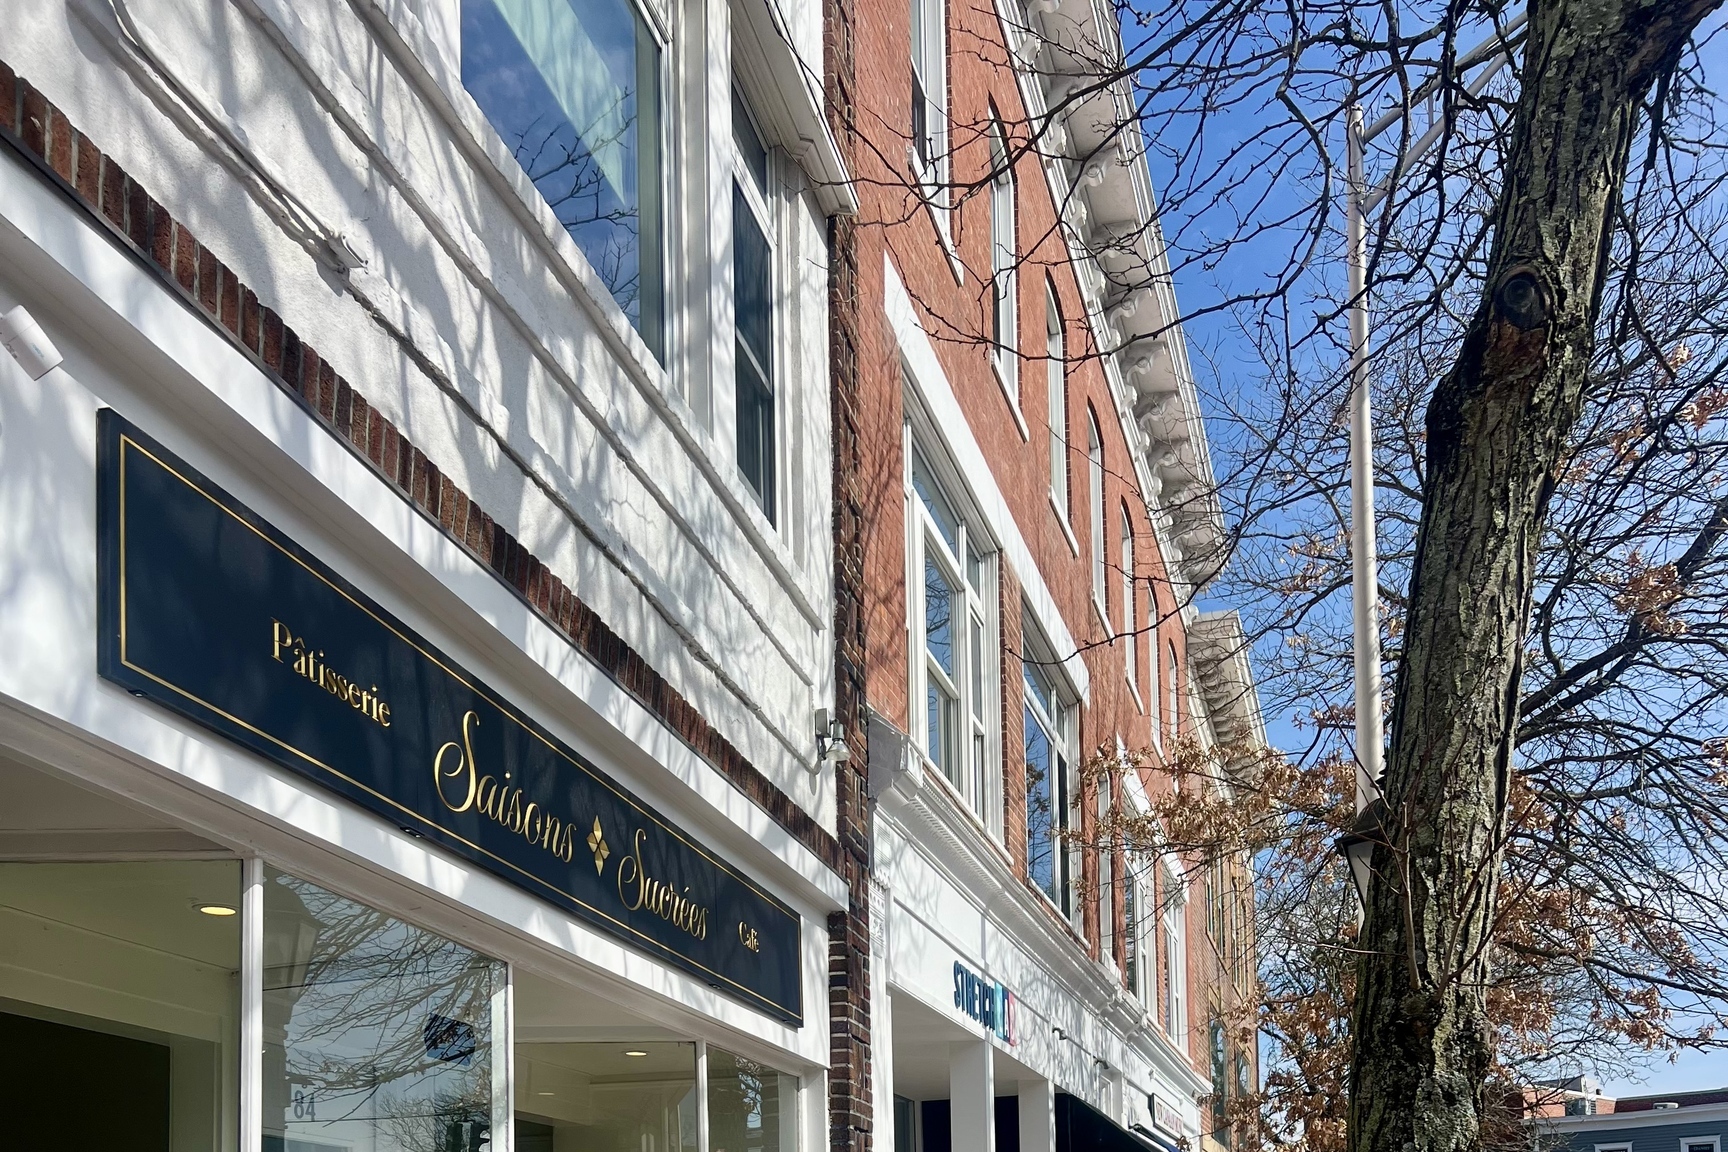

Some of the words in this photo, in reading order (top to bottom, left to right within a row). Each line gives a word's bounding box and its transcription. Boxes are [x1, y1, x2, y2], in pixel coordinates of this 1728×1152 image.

[271, 617, 391, 727] Pâtisserie
[434, 710, 577, 863] Saisons
[617, 828, 709, 941] Sucrées
[294, 1090, 316, 1122] 84
